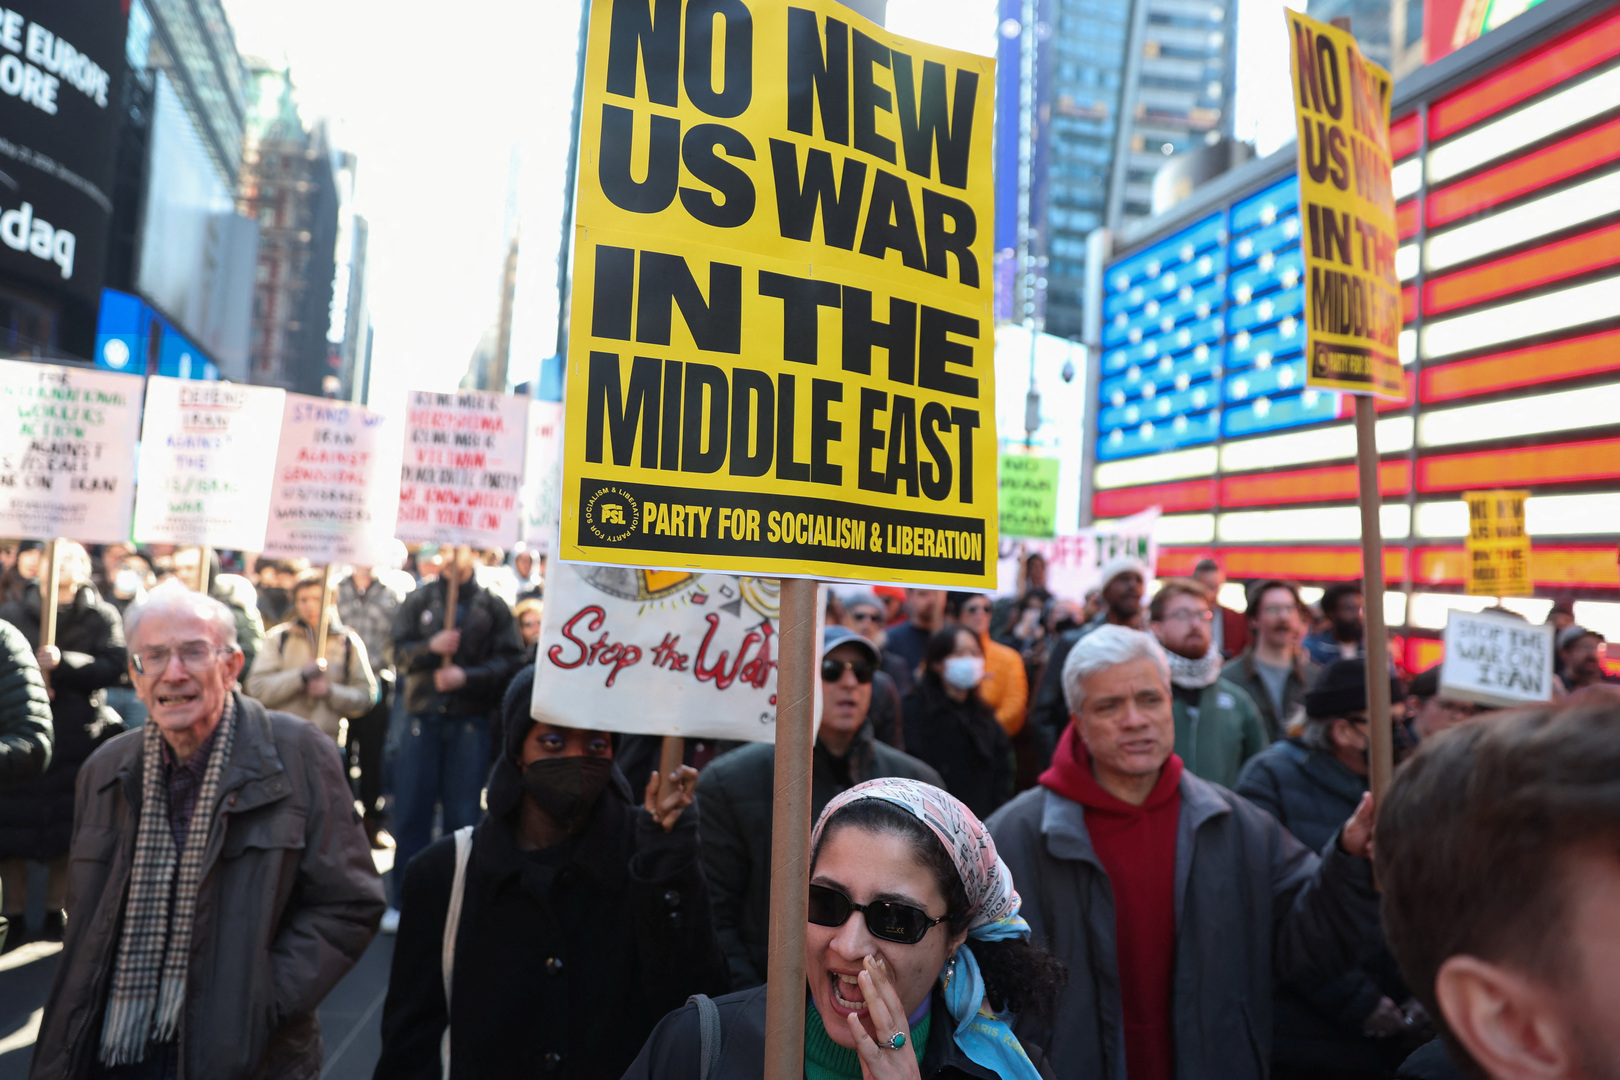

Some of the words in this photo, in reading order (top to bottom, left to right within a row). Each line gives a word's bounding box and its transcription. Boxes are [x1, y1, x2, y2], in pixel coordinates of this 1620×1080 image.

[25, 21, 110, 108] EUROPE
[1293, 20, 1344, 121] NO
[606, 0, 753, 118] NO
[787, 6, 979, 190] NEW
[1303, 115, 1349, 191] US
[599, 103, 756, 228] US
[769, 137, 980, 289] WAR
[1308, 202, 1353, 266] IN
[592, 244, 741, 354] IN
[759, 270, 980, 398] THE
[292, 403, 350, 425] STAND
[585, 351, 843, 486] MIDDLE
[858, 387, 980, 504] EAST
[297, 447, 371, 465] AGAINST
[313, 430, 357, 446] IRAN
[1005, 458, 1039, 471] NO
[586, 487, 609, 524] SOCIALISM
[601, 505, 626, 524] PSL
[618, 489, 639, 531] LIBERATION
[590, 525, 605, 539] FOR
[607, 530, 631, 542] PARTY
[642, 502, 711, 538] PARTY
[718, 508, 760, 542] FOR
[767, 511, 865, 551] SOCIALISM
[870, 522, 882, 553] &
[887, 526, 982, 562] LIBERATION
[549, 606, 642, 687] Stop
[651, 632, 689, 672] the
[1458, 620, 1502, 641] STOP
[1508, 626, 1545, 648] THE
[1455, 640, 1502, 663] WAR
[1507, 649, 1546, 673] ON
[1477, 664, 1543, 694] IRAN
[968, 1022, 999, 1037] PARIS
